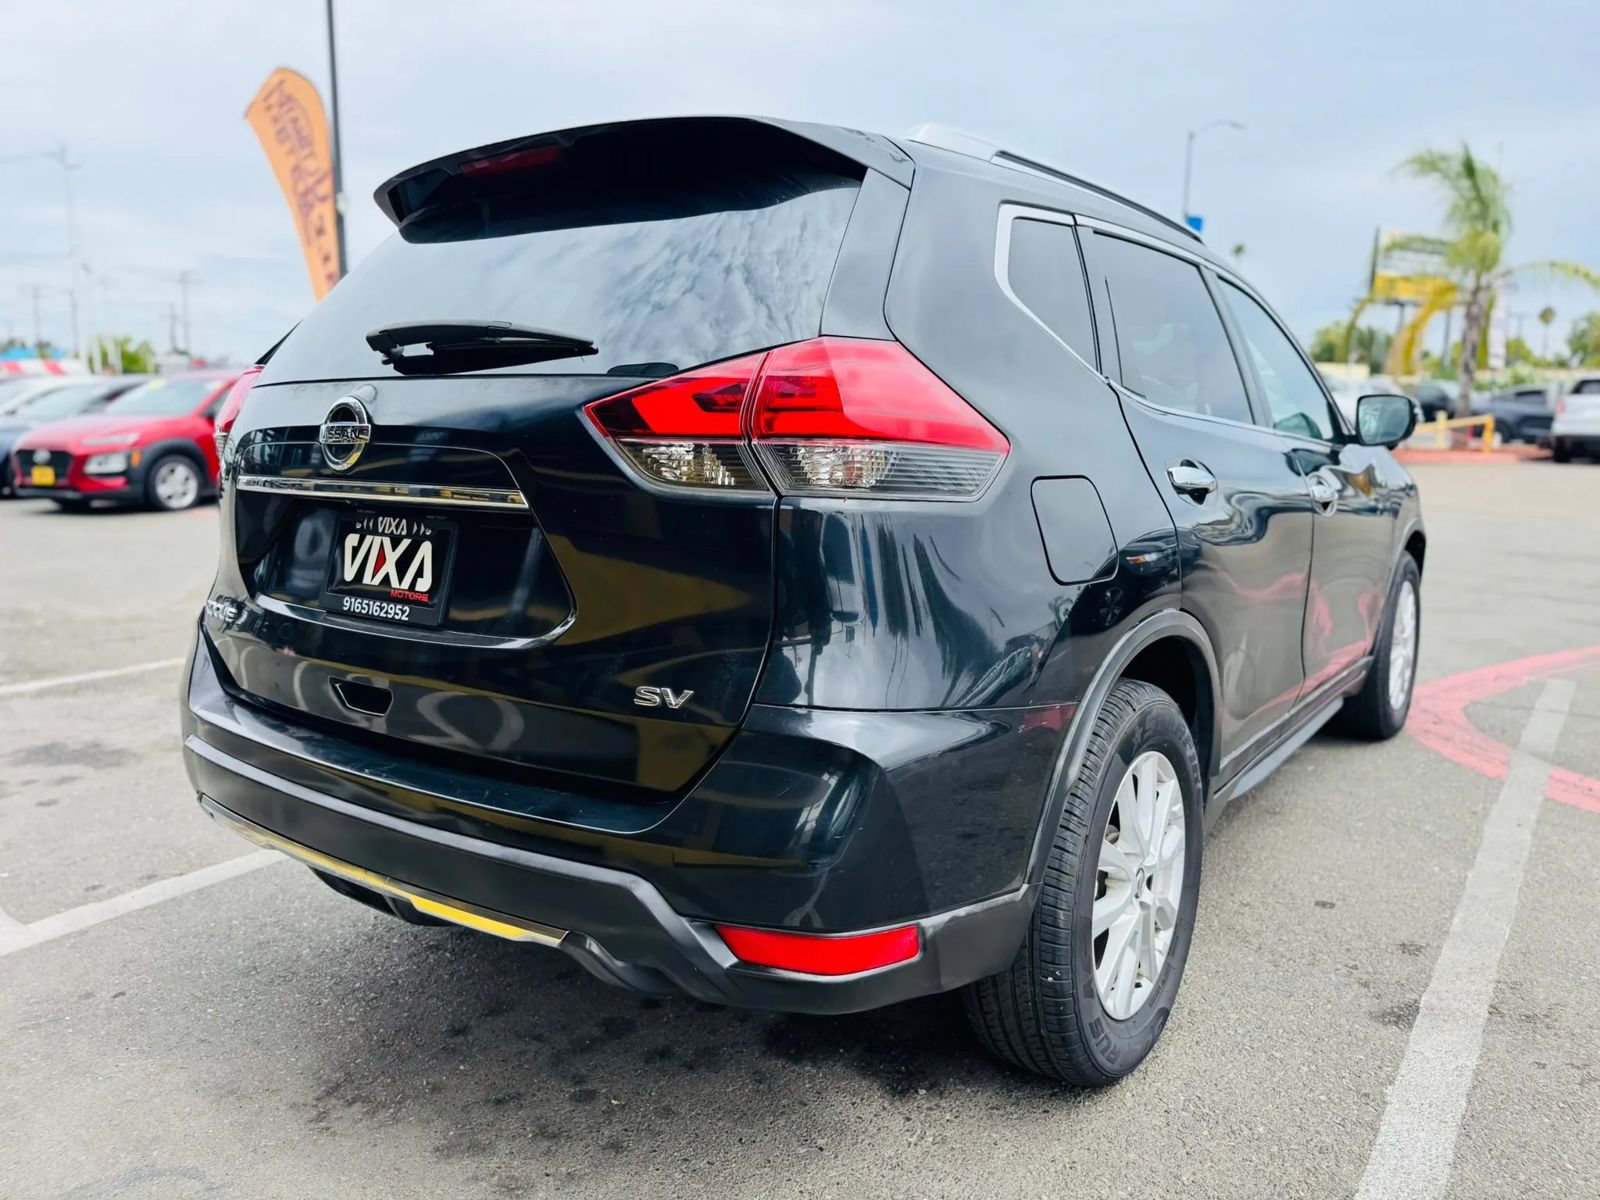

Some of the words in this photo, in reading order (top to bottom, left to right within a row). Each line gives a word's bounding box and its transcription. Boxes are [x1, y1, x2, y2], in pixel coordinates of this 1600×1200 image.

[378, 516, 407, 536] VIXA
[343, 533, 433, 593] VIXA
[390, 589, 430, 603] MOTORS
[342, 597, 410, 621] 9165162952
[634, 685, 694, 709] SV
